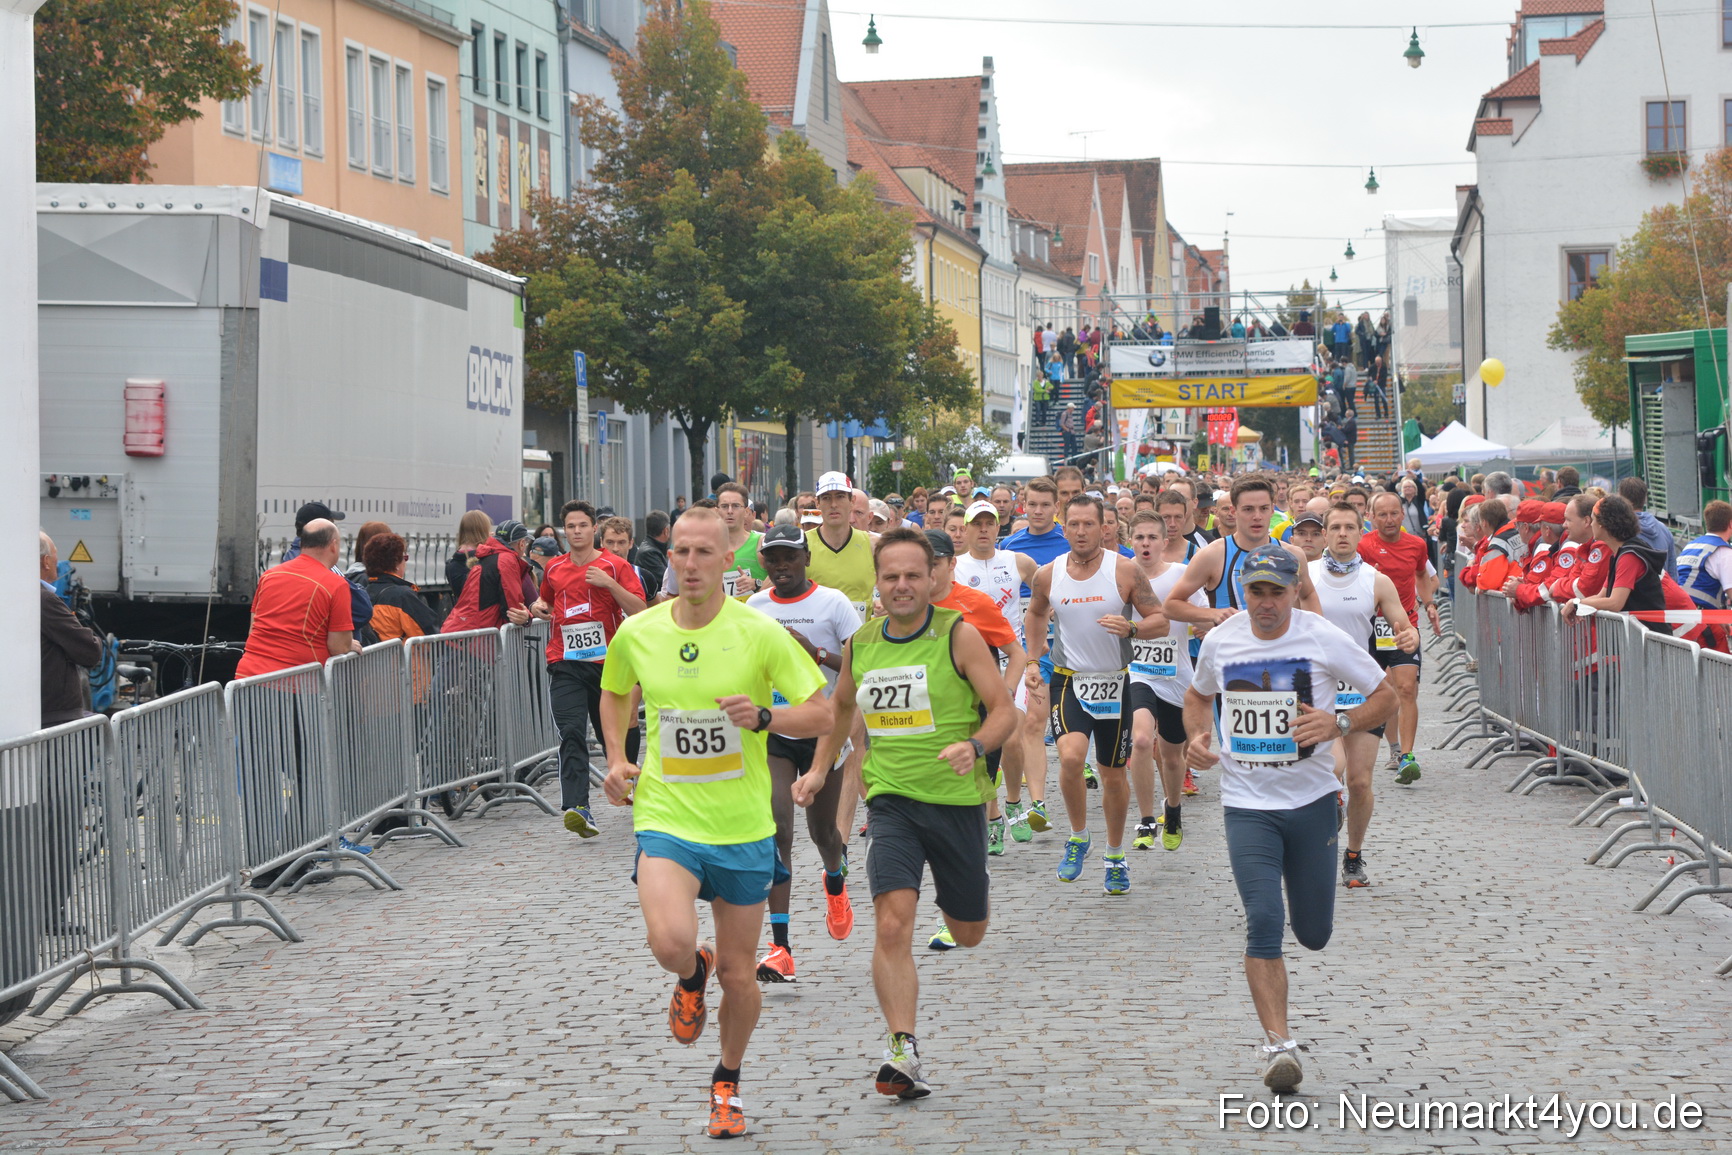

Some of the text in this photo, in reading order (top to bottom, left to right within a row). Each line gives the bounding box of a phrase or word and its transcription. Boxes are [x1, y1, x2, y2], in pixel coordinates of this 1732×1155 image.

[467, 345, 513, 416] BOCK
[1178, 383, 1248, 400] START
[567, 631, 601, 649] 2853
[1134, 645, 1173, 663] 2730
[678, 666, 699, 675] Partl
[879, 674, 912, 683] Neumarkt
[869, 684, 911, 710] 227
[1080, 682, 1118, 700] 2232
[660, 715, 726, 724] PARTL Neumarkt
[880, 715, 913, 726] Richard
[1232, 708, 1290, 734] 2013
[675, 727, 726, 754] 635
[1236, 740, 1286, 752] Hans-Peter
